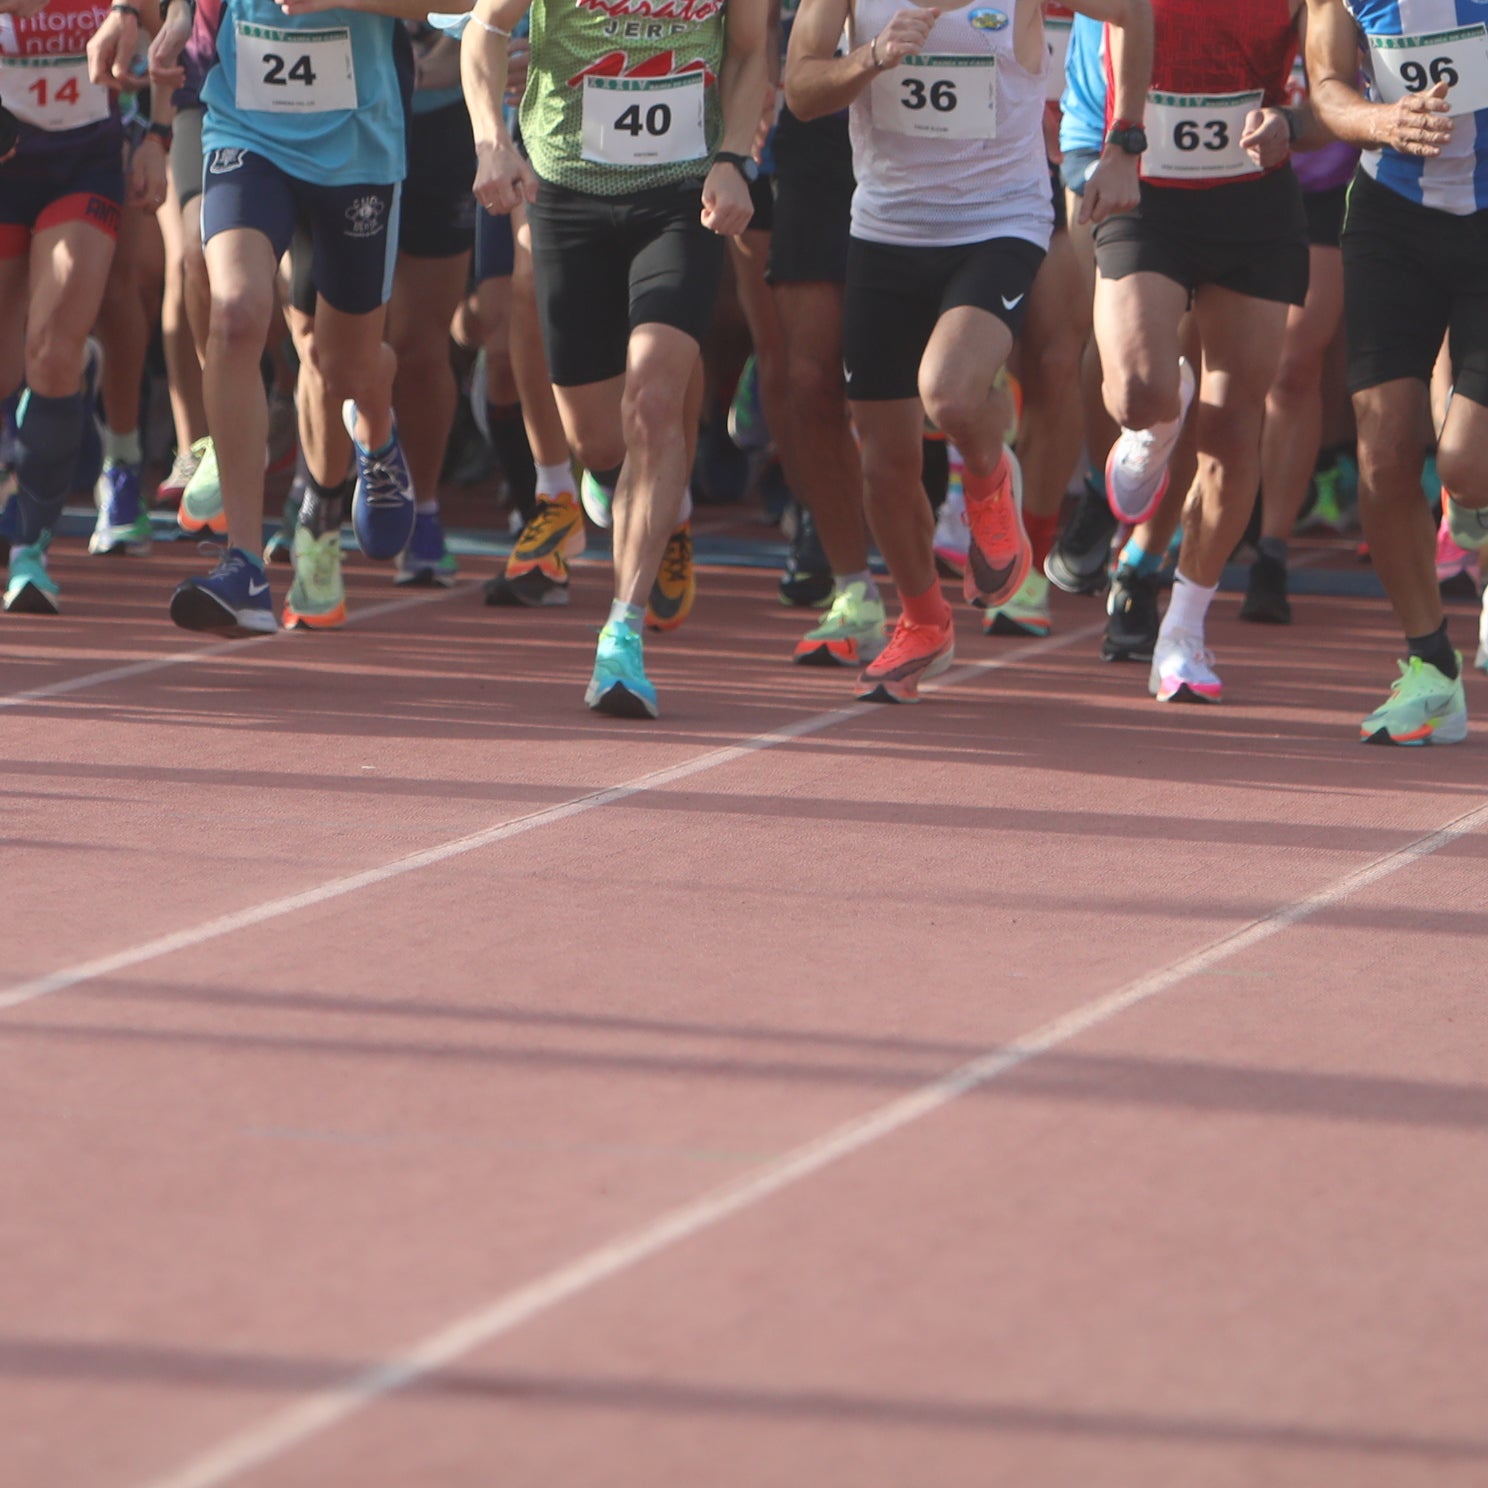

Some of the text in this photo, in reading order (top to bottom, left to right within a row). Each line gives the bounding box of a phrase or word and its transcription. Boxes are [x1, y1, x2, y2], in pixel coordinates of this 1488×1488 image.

[262, 53, 317, 87] 24
[1399, 56, 1459, 93] 96
[28, 77, 81, 107] 14
[900, 77, 958, 112] 36
[613, 102, 672, 137] 40
[1173, 119, 1230, 152] 63
